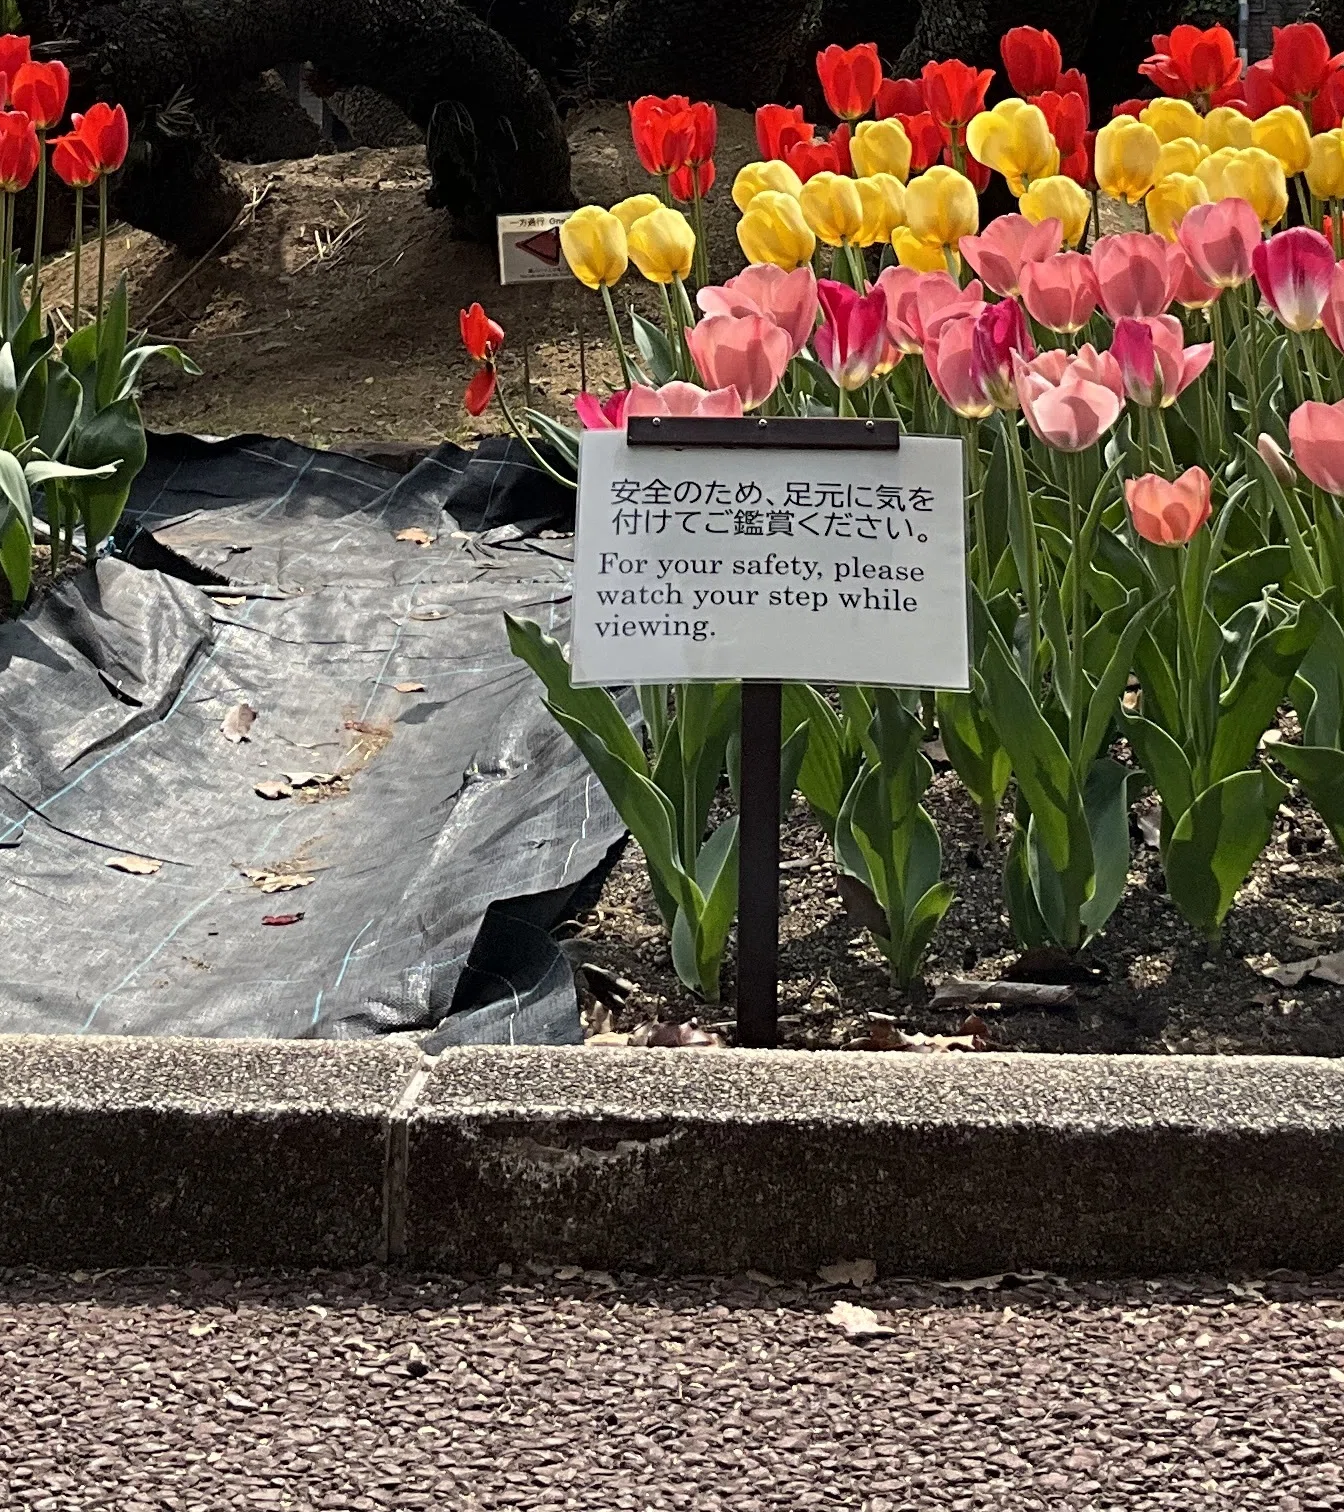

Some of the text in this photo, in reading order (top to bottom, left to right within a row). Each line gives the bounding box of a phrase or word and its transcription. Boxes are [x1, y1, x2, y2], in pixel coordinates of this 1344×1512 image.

[611, 478, 935, 512] 安全のため、足元に気を
[612, 508, 928, 543] 付けてご鑑賞ください。
[598, 552, 925, 582] For your safety, please
[596, 582, 918, 612] watch your step while
[594, 613, 716, 642] viewing.
